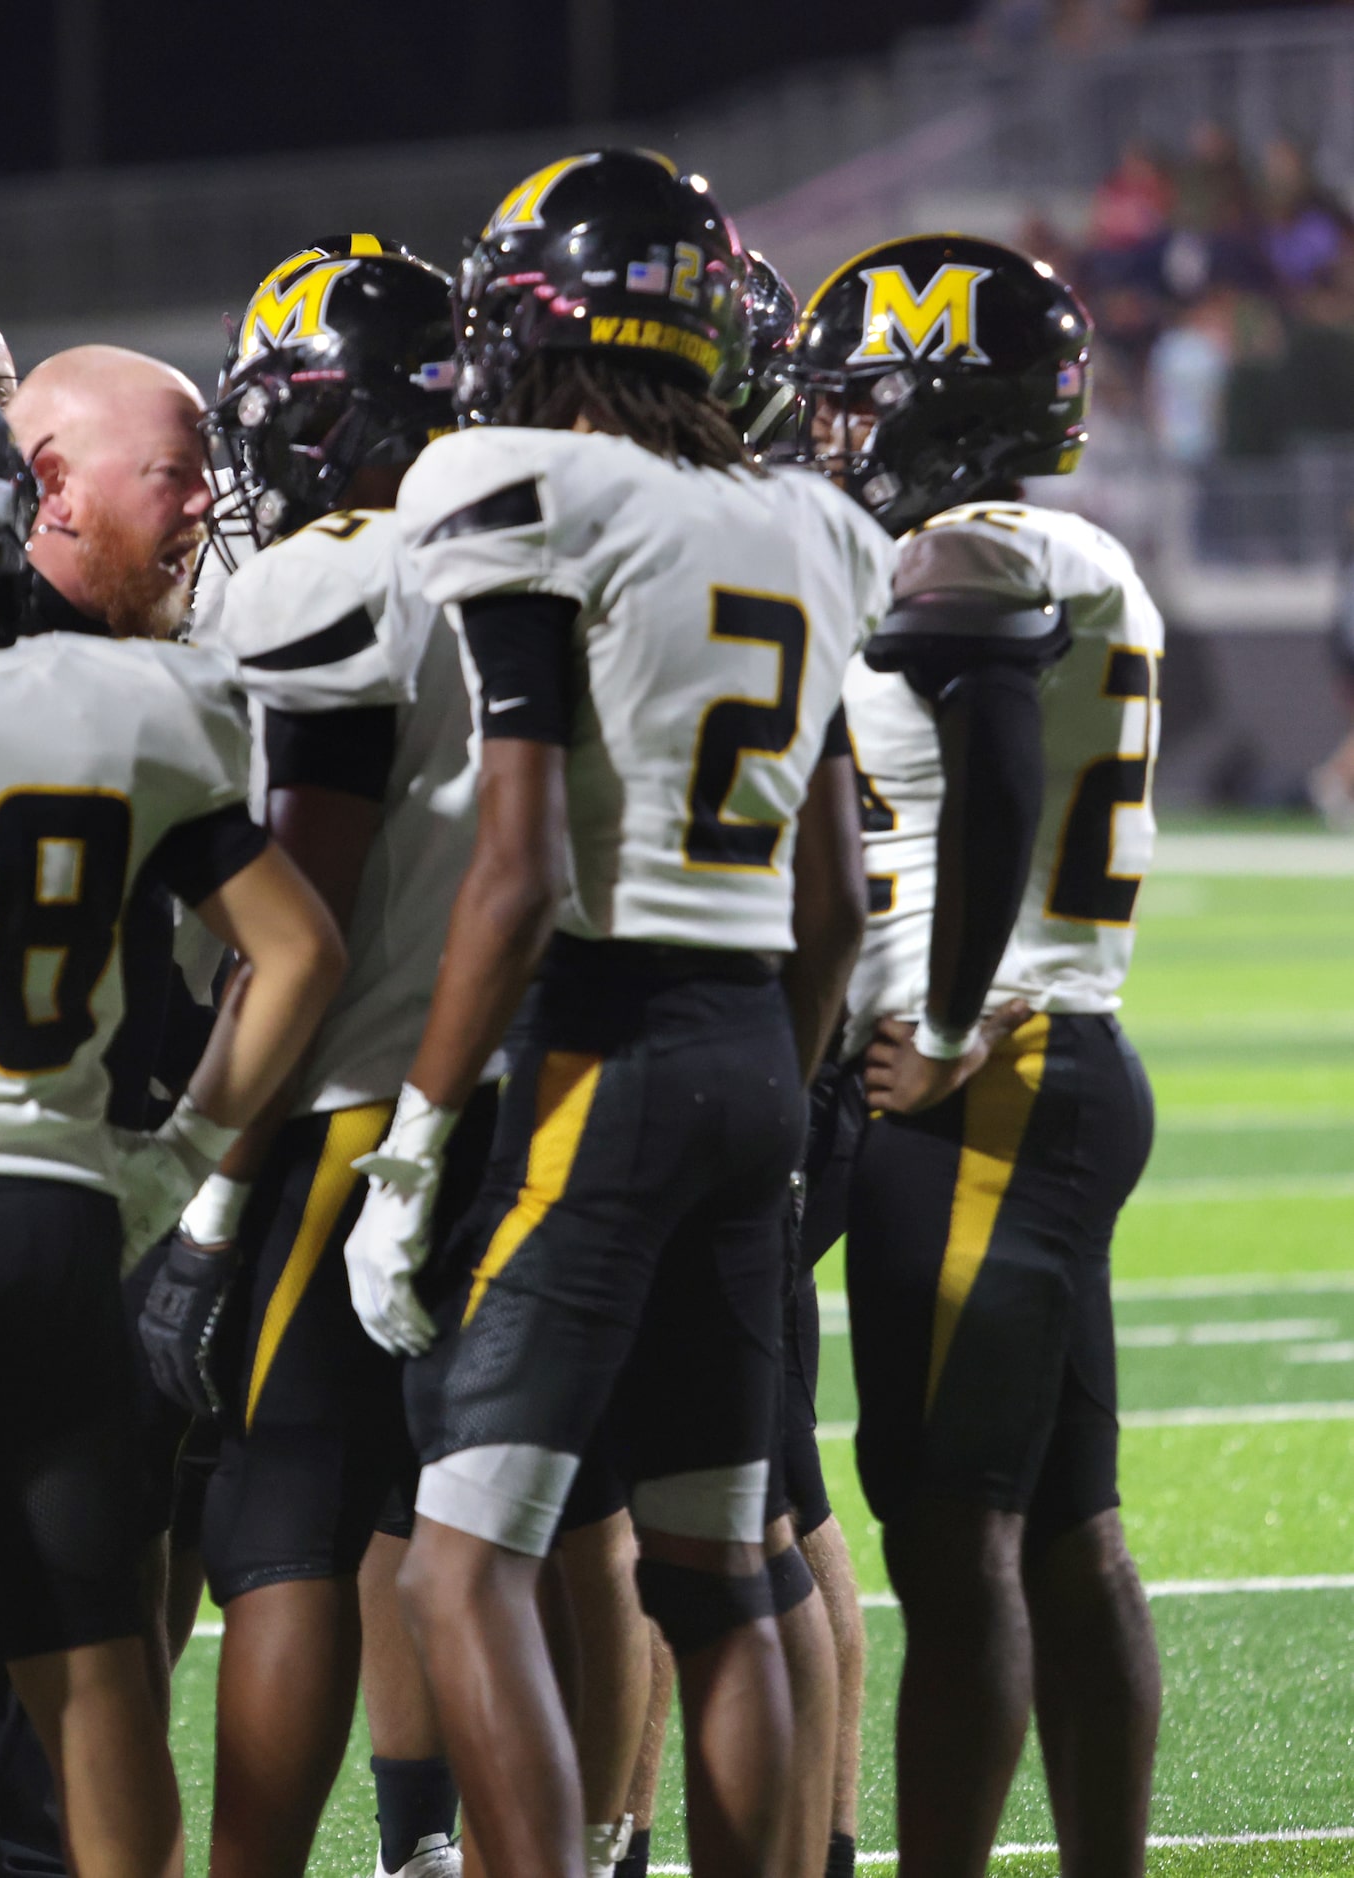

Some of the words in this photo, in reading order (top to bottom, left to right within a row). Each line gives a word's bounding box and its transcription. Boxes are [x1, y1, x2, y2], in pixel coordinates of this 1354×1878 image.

[229, 258, 362, 380] M
[669, 241, 704, 306] 2
[845, 263, 993, 366] M
[683, 585, 810, 875] 2
